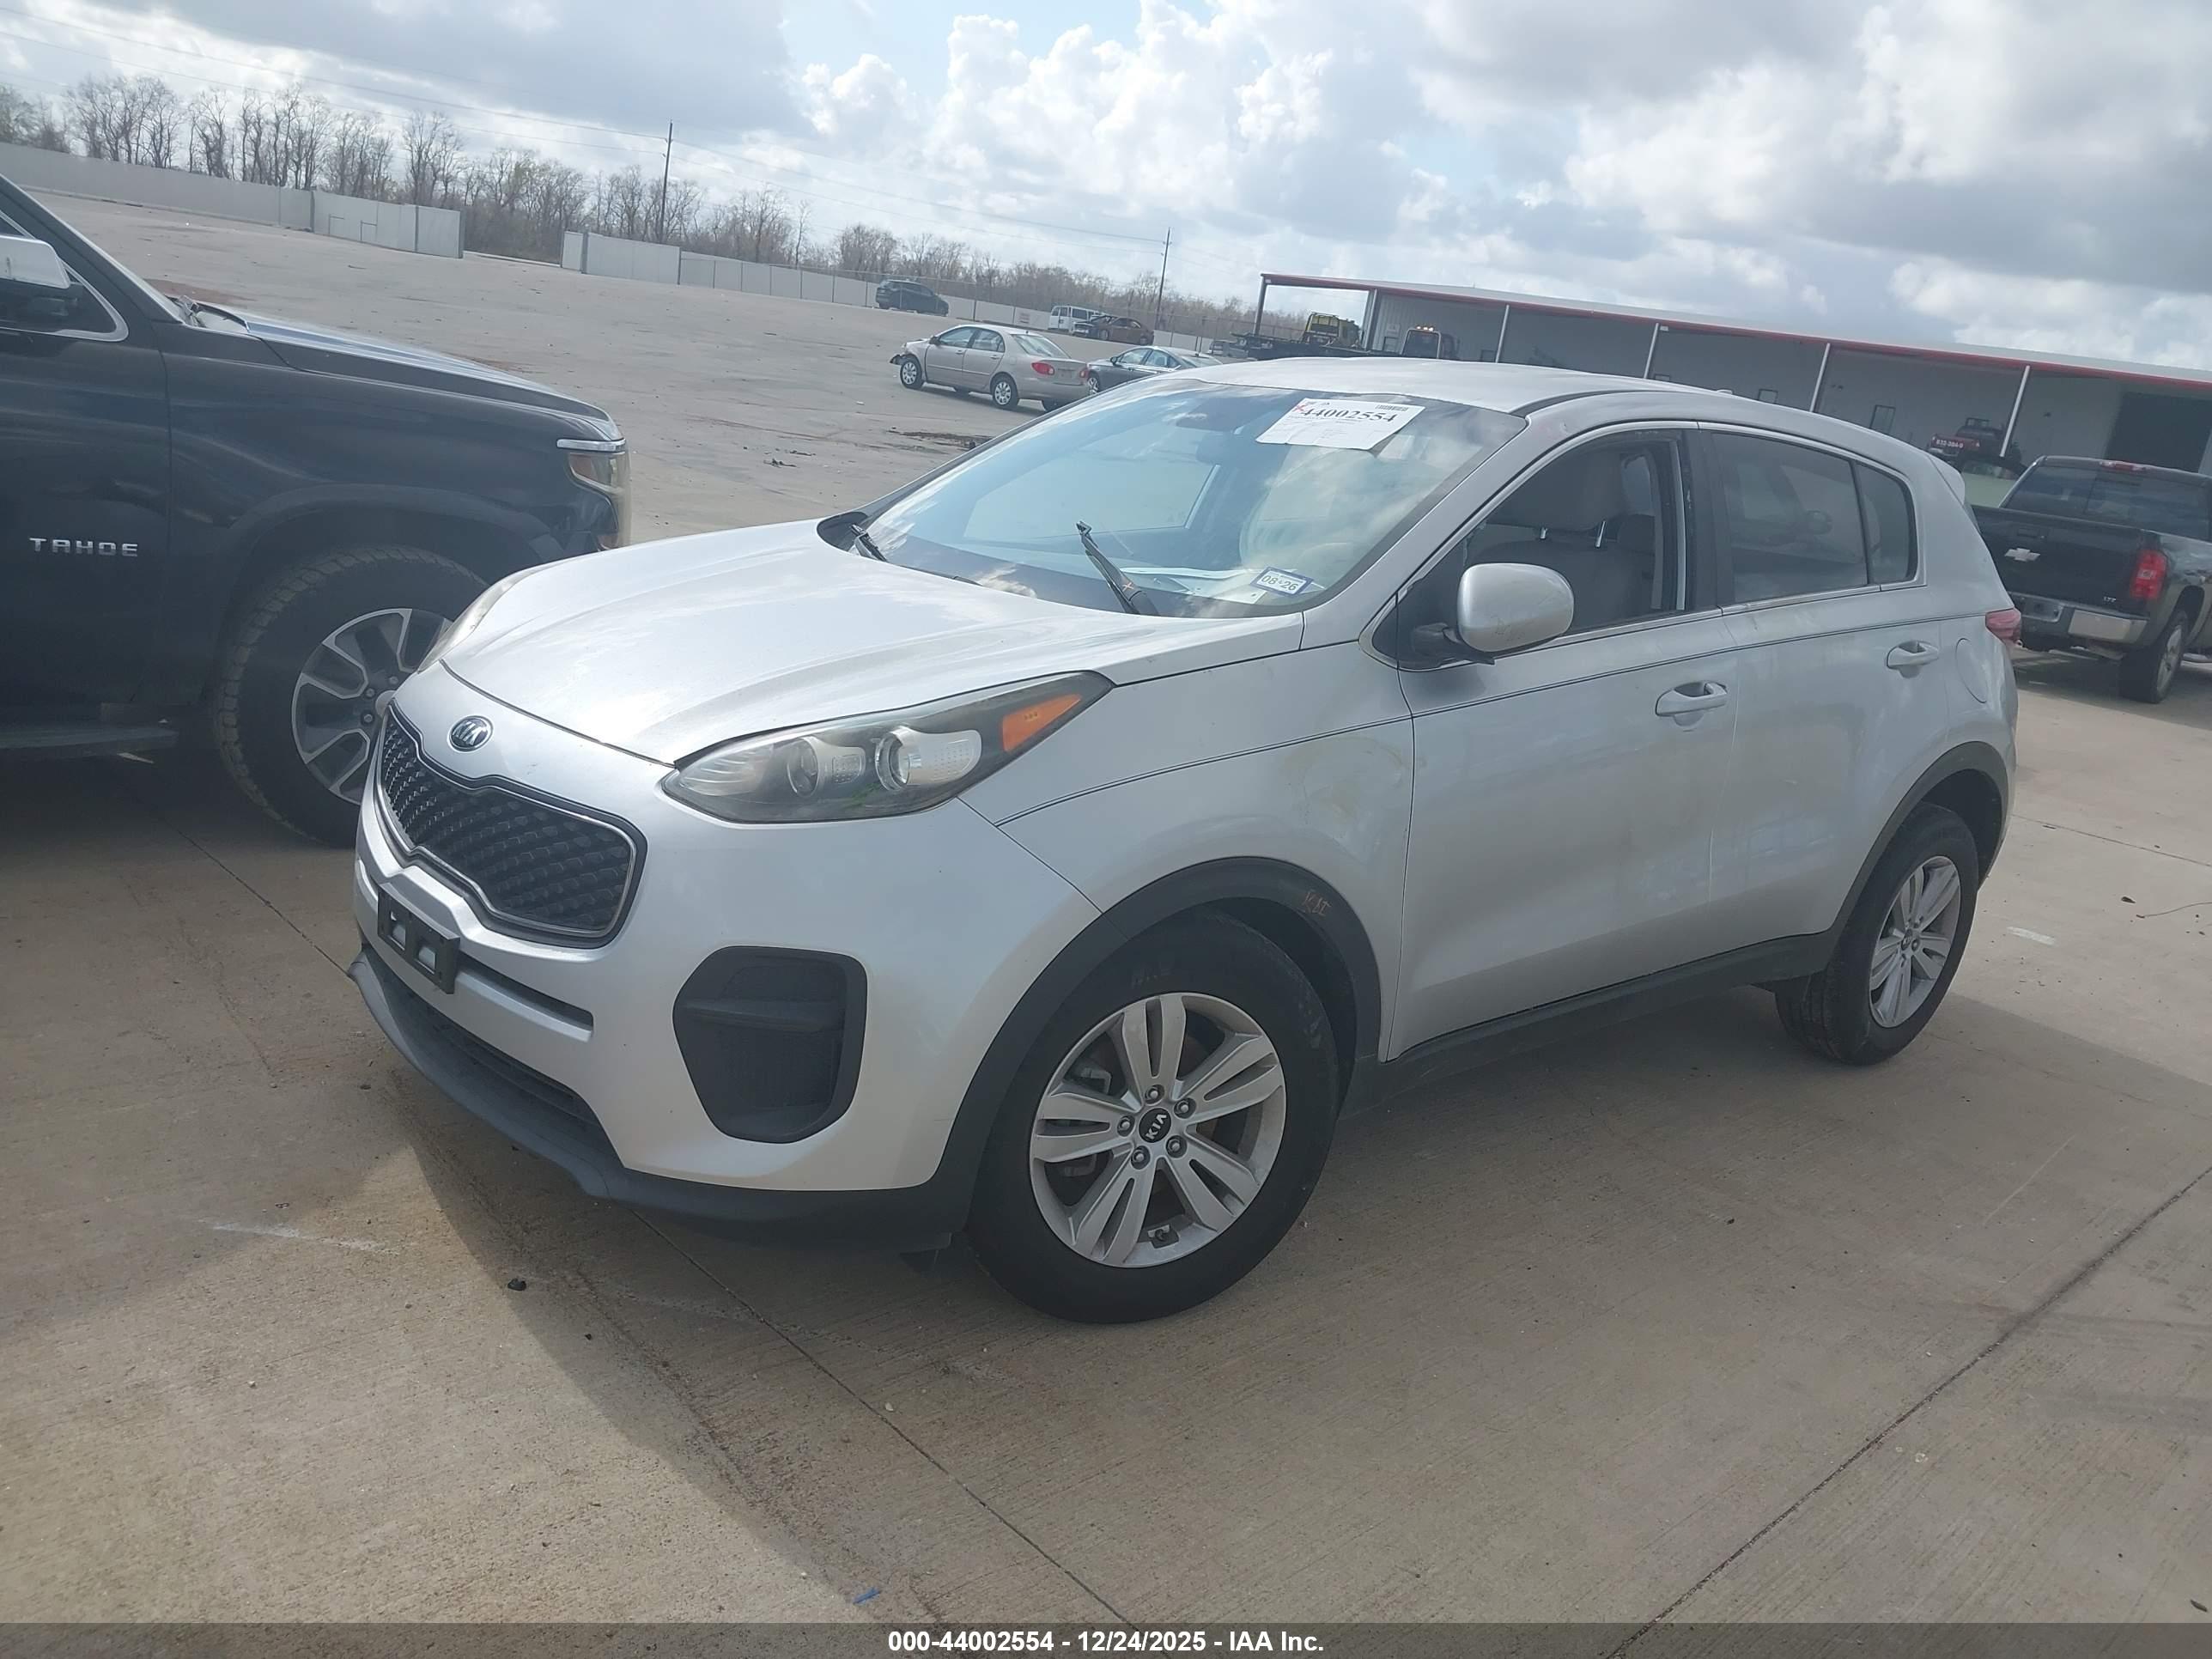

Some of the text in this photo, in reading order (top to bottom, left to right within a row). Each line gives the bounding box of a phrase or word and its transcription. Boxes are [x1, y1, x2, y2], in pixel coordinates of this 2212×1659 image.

[1301, 408, 1398, 422] 44002554
[29, 538, 138, 556] TAHOE
[1261, 574, 1278, 585] 08
[1280, 580, 1298, 591] 26
[452, 721, 488, 745] KIA
[1145, 1114, 1167, 1139] KIA
